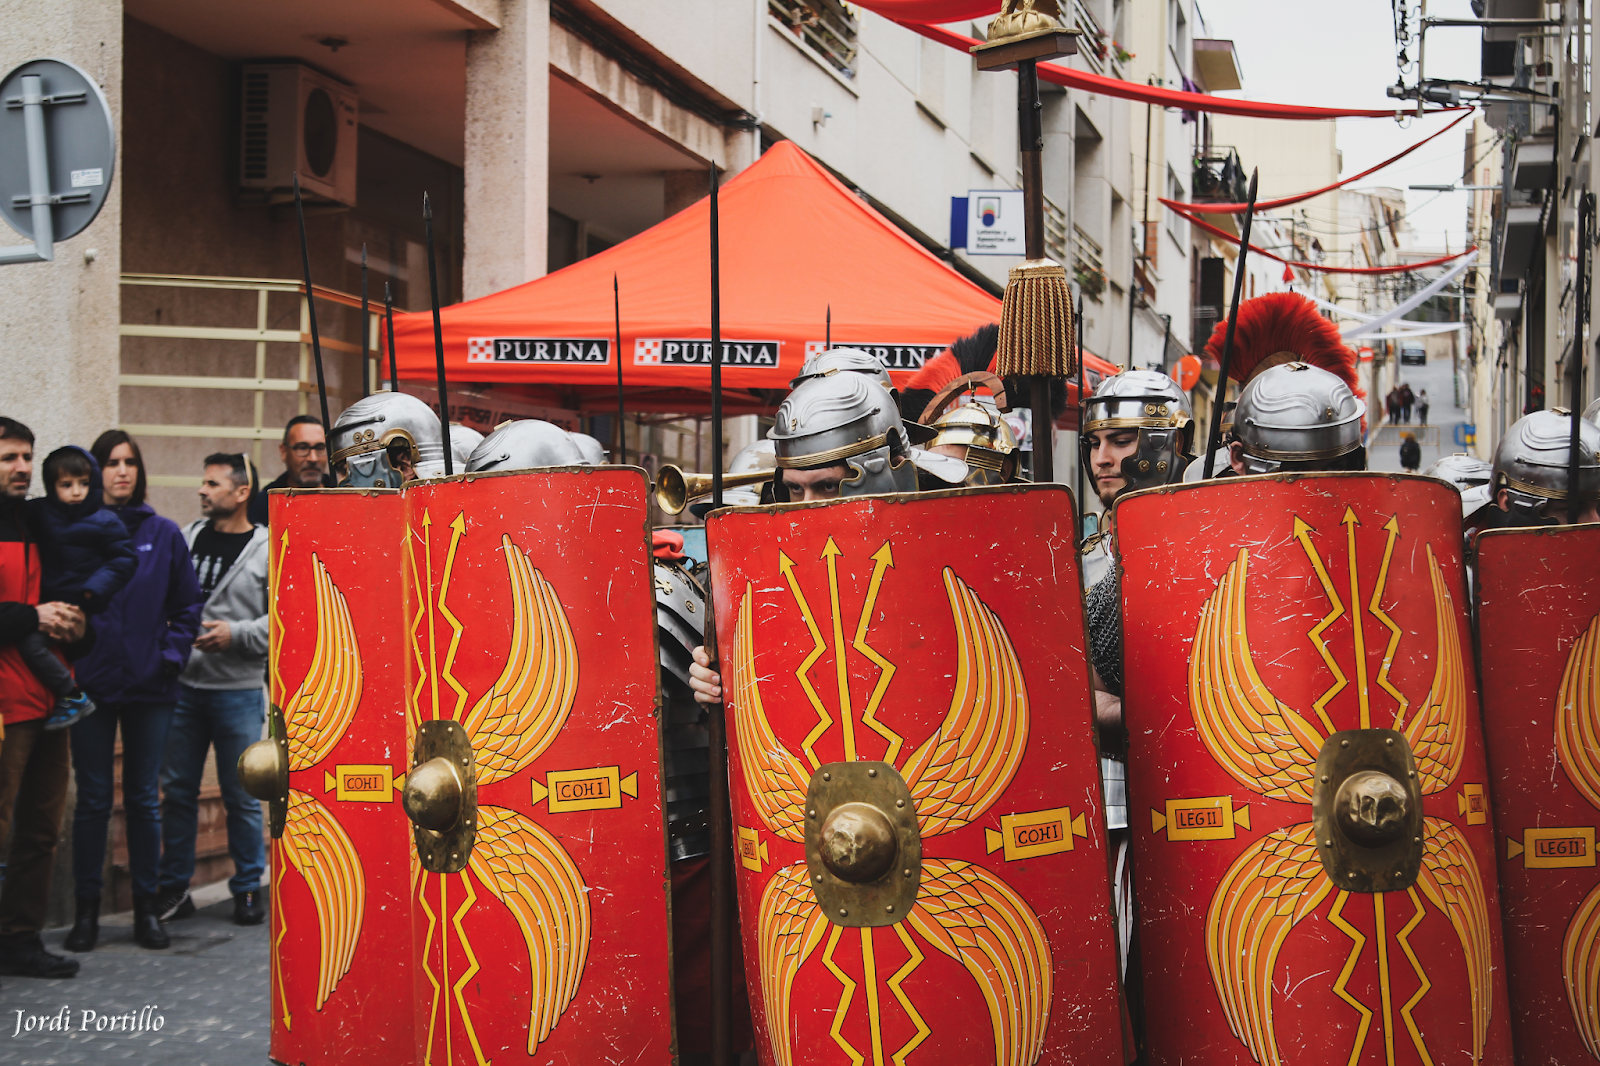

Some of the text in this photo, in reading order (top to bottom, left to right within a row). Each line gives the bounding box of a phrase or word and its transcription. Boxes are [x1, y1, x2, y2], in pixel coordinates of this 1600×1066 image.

[497, 341, 605, 361] PURINA
[664, 342, 774, 364] PURINA
[346, 777, 377, 790] COHI
[561, 782, 604, 798] COHI
[1018, 824, 1059, 845] COHI
